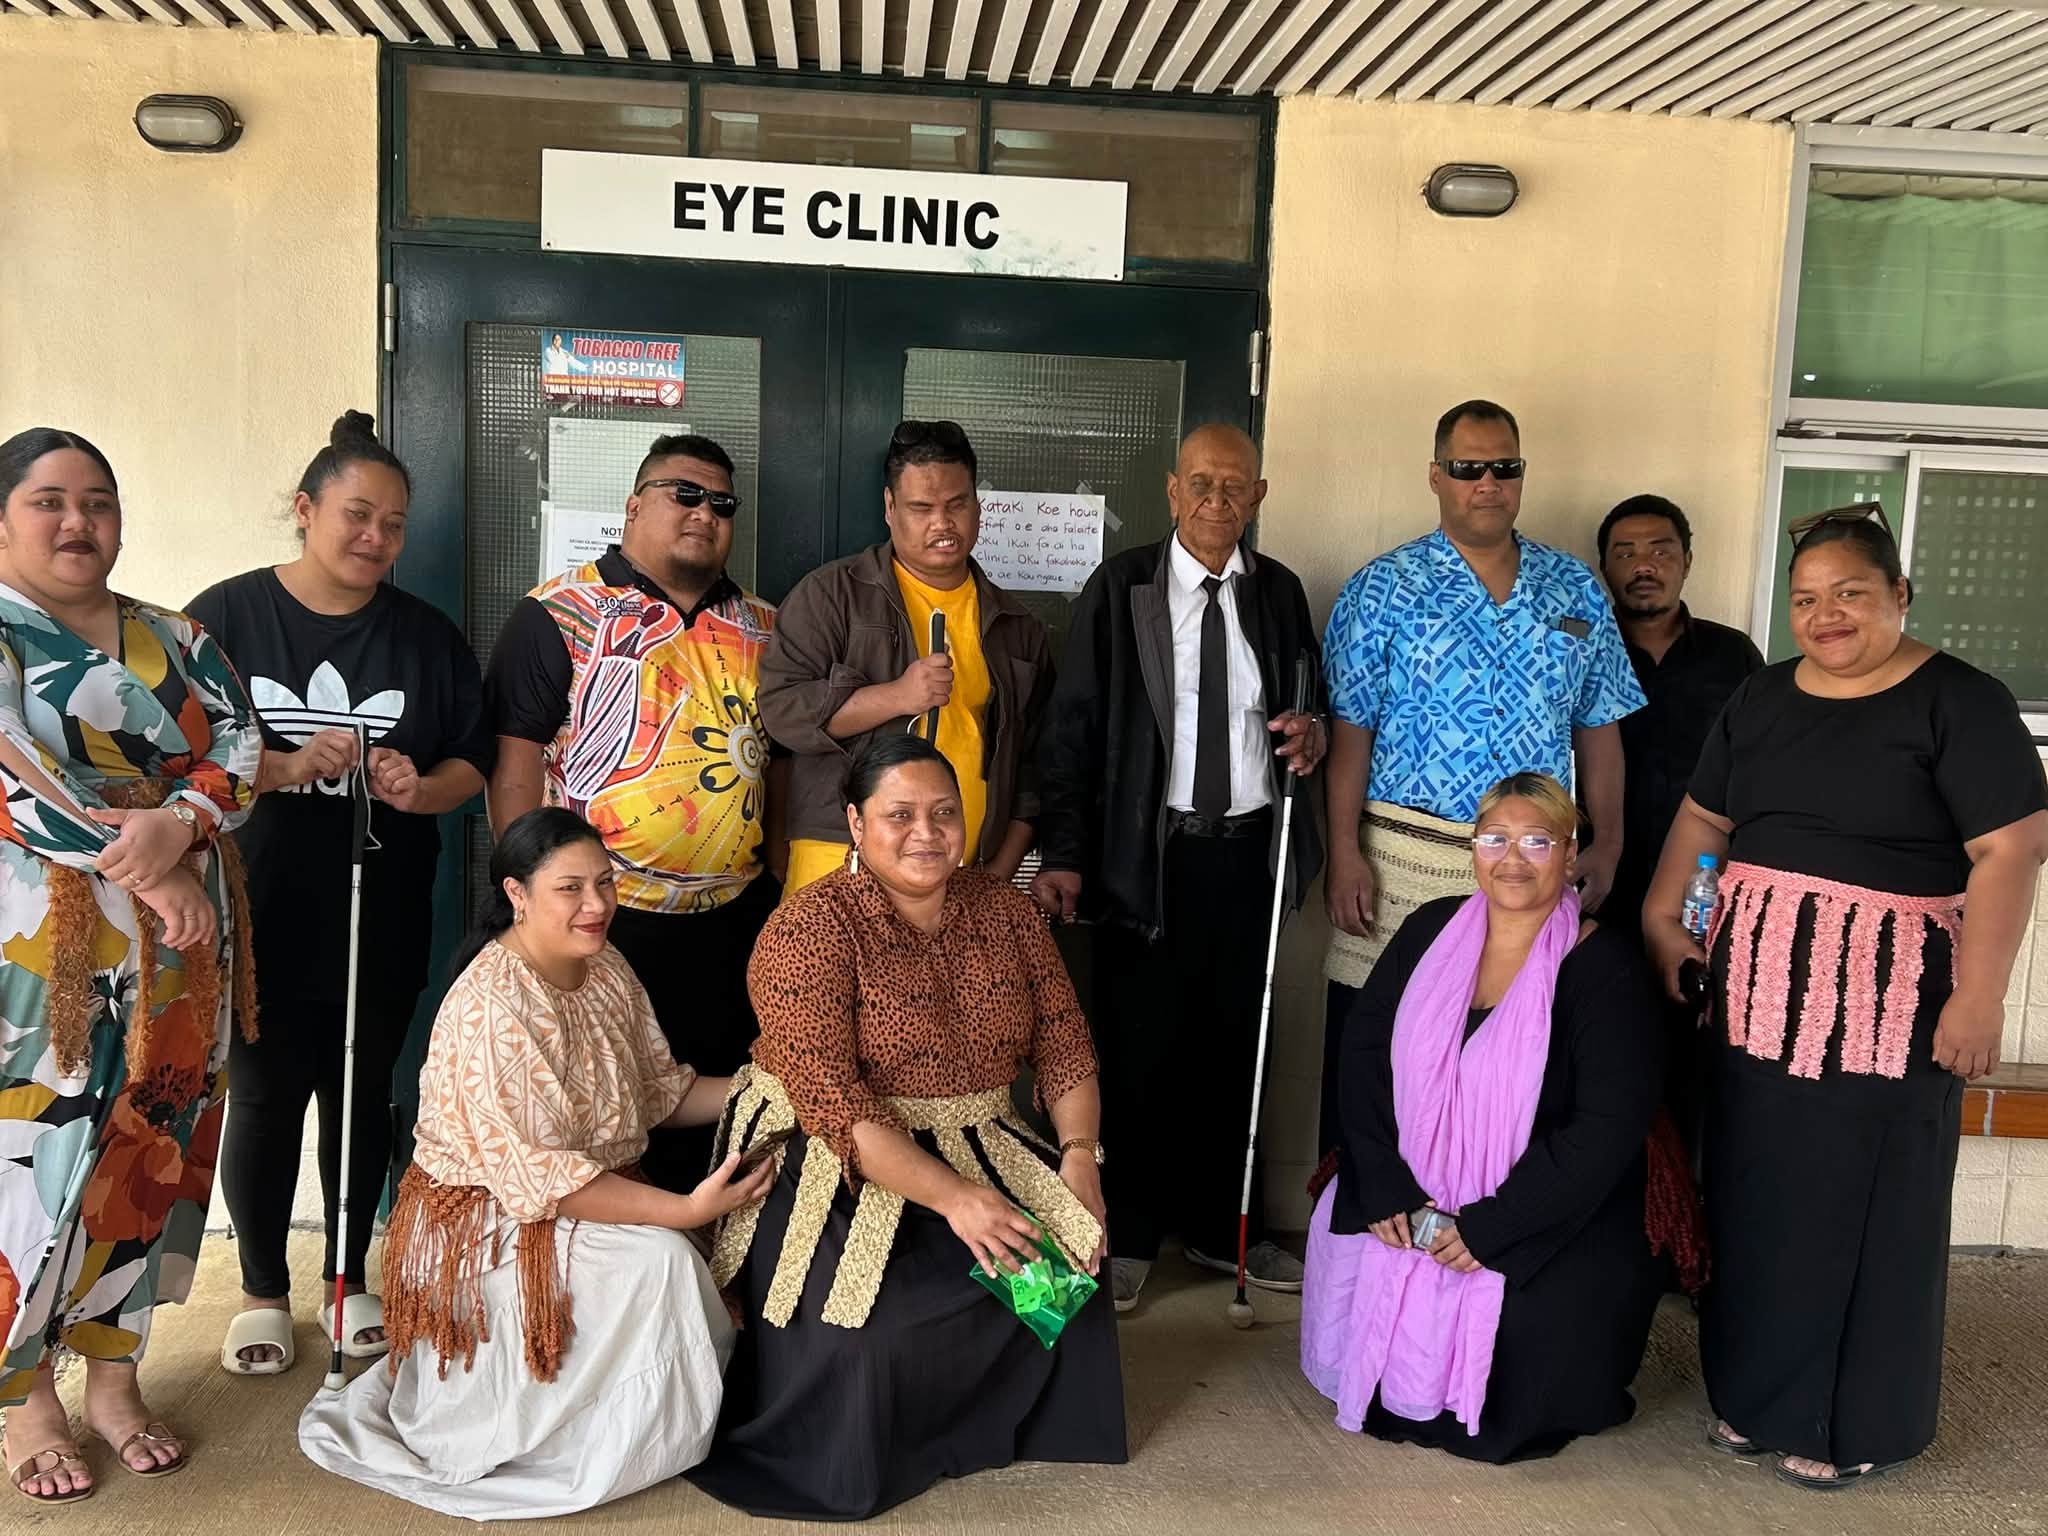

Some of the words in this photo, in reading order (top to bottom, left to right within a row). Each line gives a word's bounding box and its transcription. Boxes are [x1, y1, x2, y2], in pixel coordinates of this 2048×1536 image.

[674, 181, 785, 235] EYE
[806, 190, 1000, 250] CLINIC
[573, 338, 643, 358] TOBACCO
[646, 343, 680, 360] FREE
[593, 360, 677, 378] HOSPITAL
[545, 384, 570, 394] THANK
[572, 385, 587, 395] YOU
[588, 386, 603, 396] FOR
[604, 387, 620, 397] NOT
[621, 389, 656, 398] SMOKING
[596, 596, 618, 611] 50
